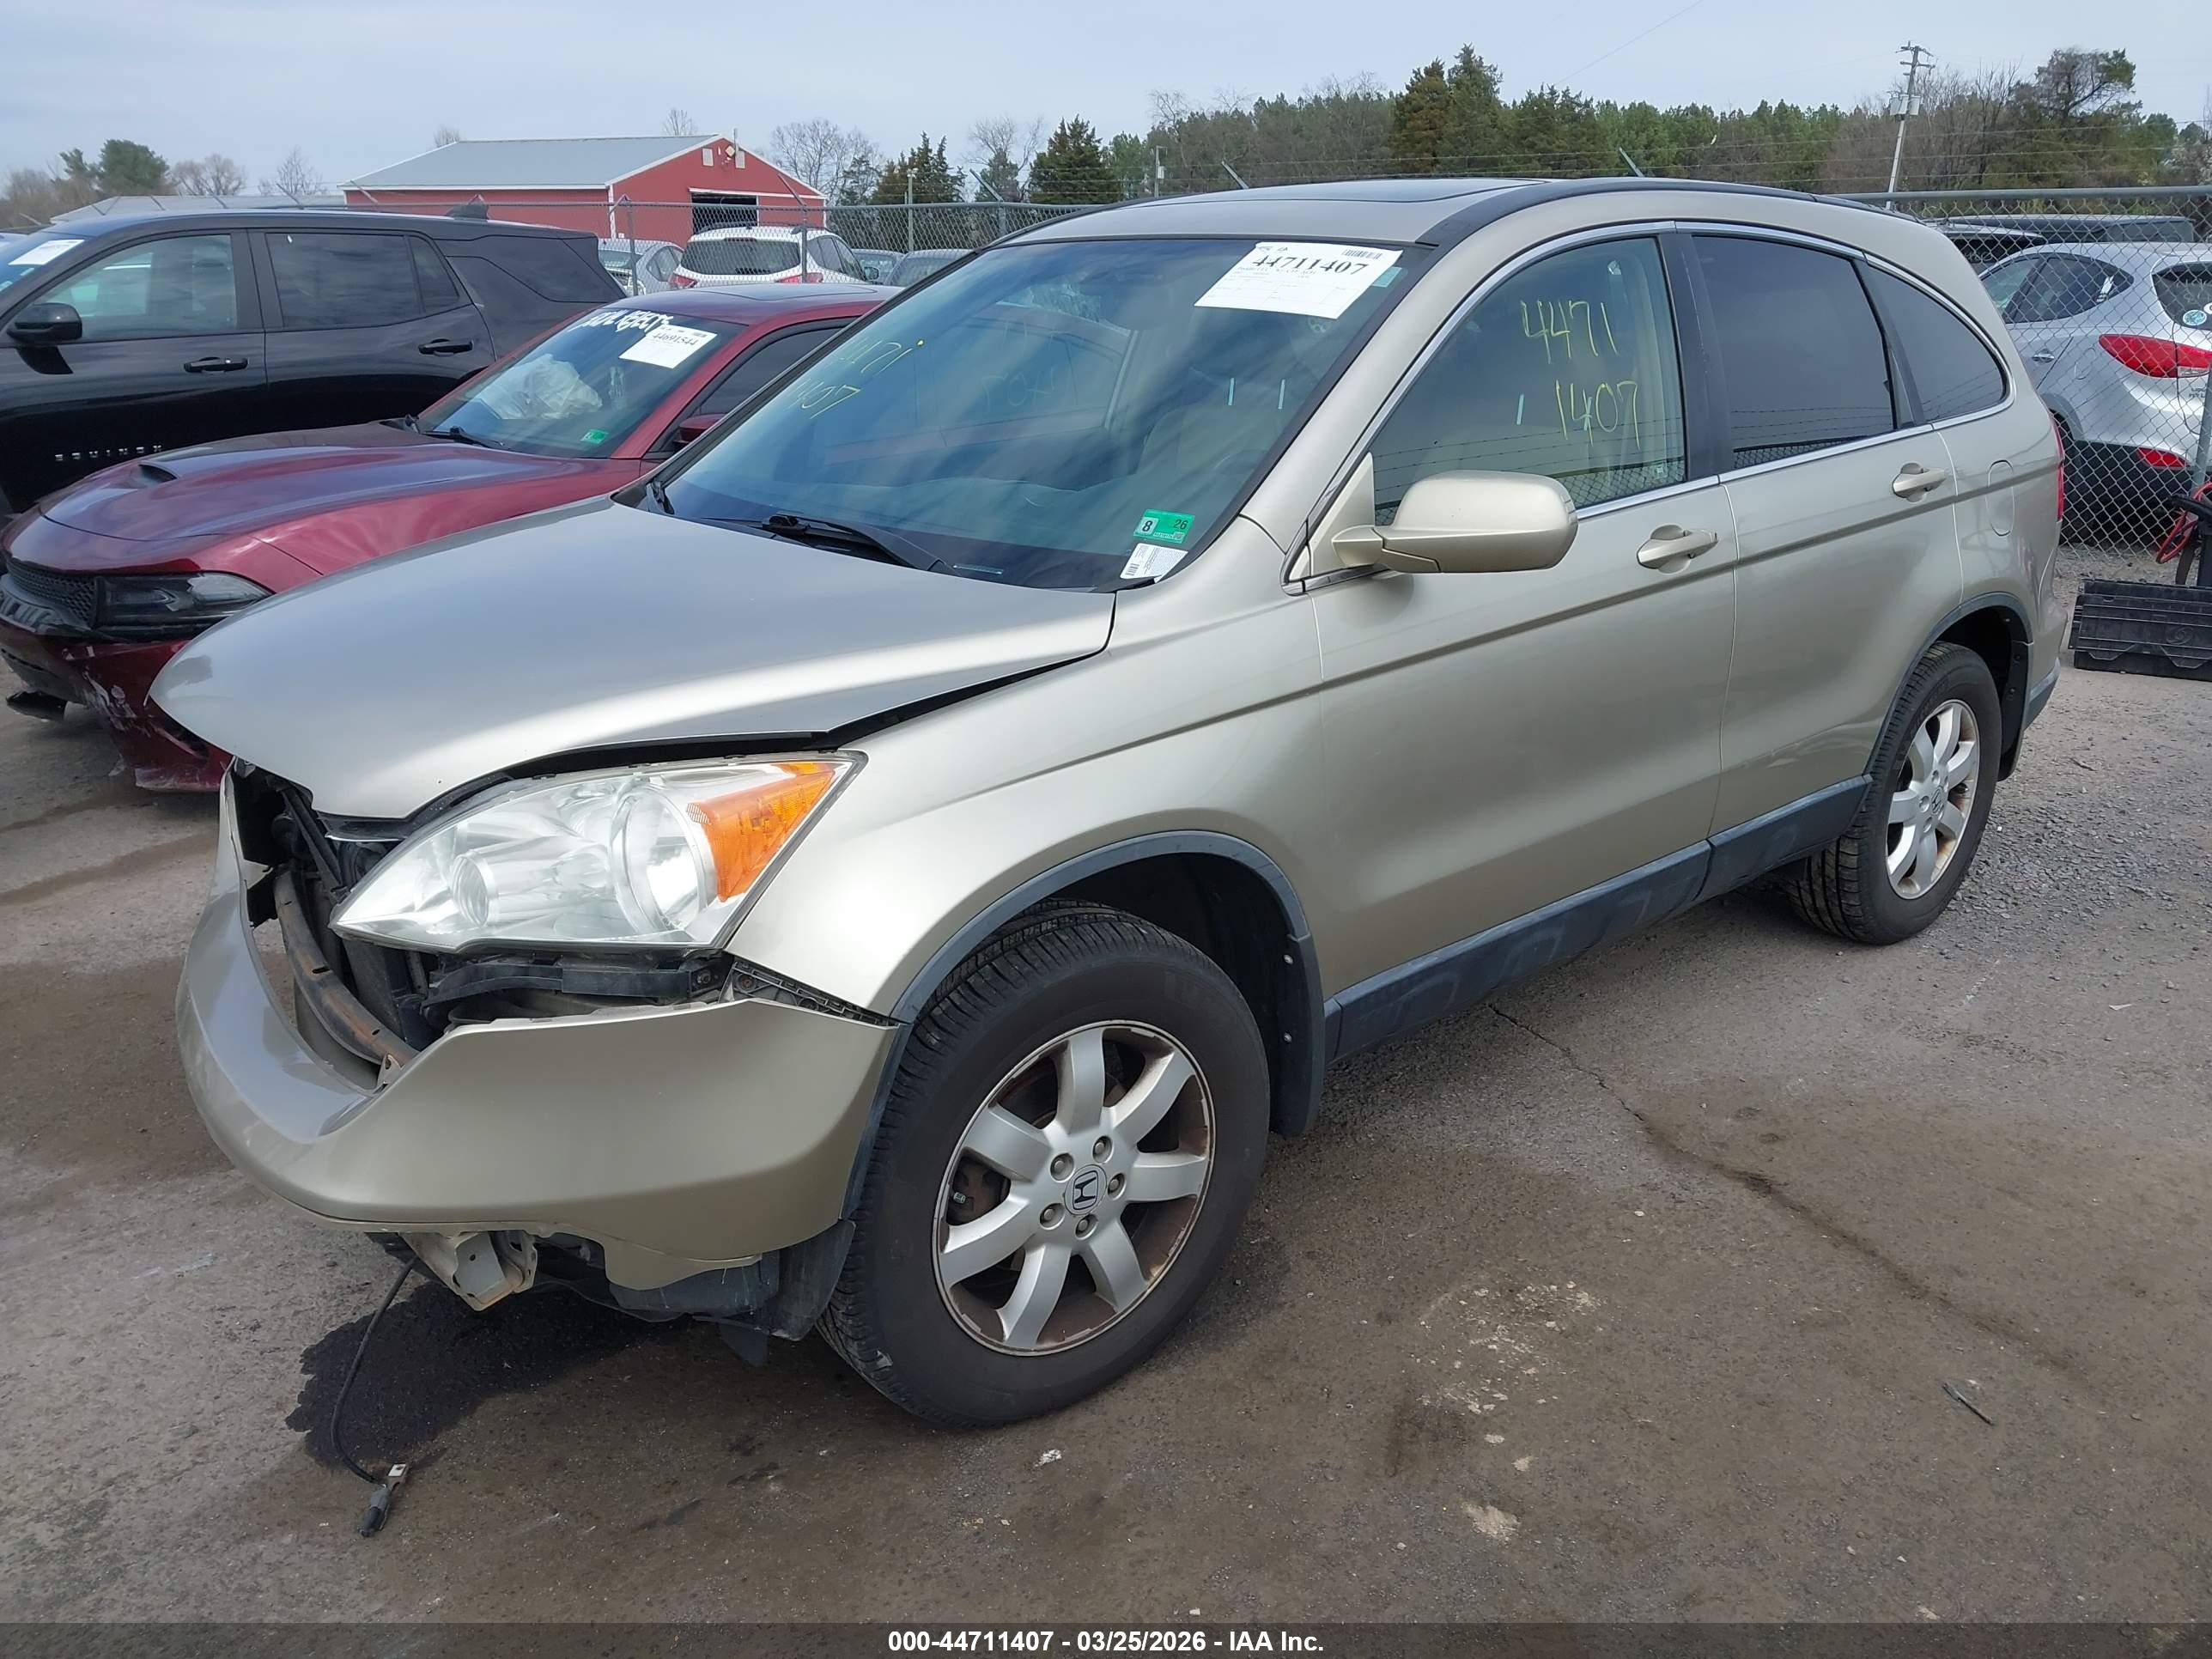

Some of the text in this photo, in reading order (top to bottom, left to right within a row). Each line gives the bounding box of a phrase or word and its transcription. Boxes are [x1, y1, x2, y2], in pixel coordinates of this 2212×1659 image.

[1253, 255, 1369, 275] 44711407
[1521, 299, 1620, 364] 4471
[1556, 380, 1640, 450] 1407
[1142, 520, 1188, 532] 8 26
